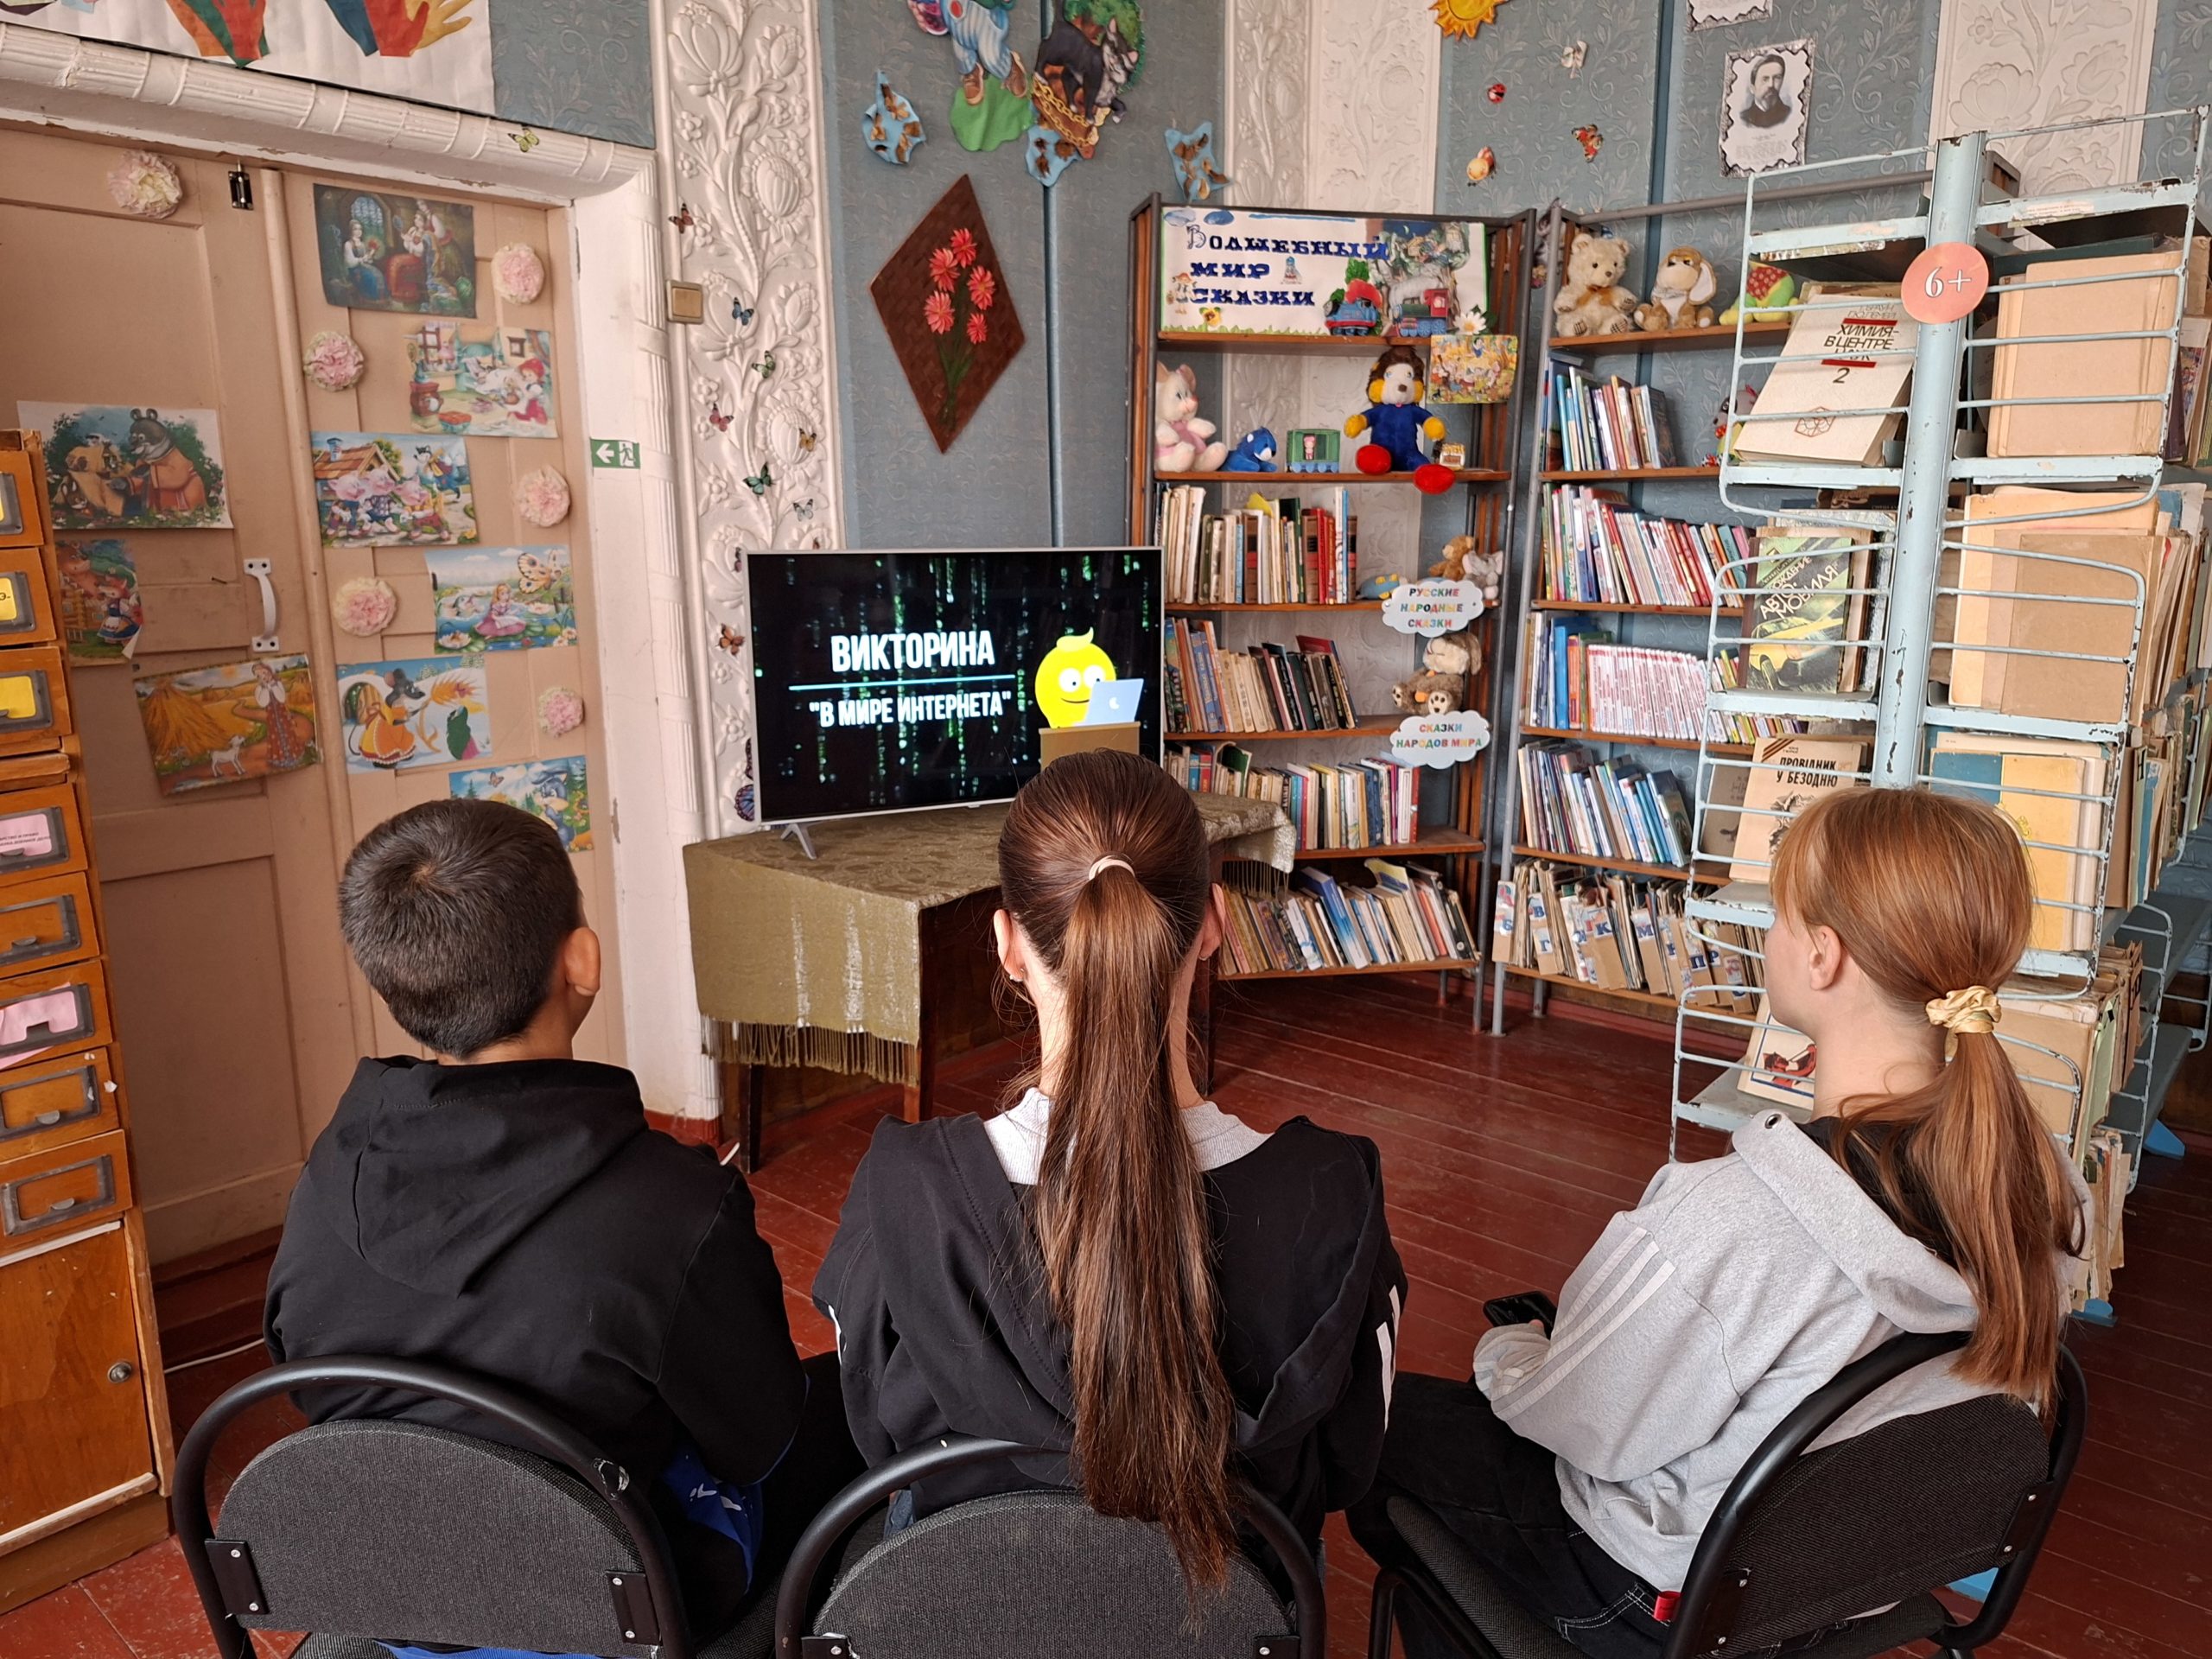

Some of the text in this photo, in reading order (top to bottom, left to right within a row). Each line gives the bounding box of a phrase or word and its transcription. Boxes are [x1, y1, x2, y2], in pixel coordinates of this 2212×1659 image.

[1924, 266, 1972, 298] 6+
[1824, 335, 1894, 350] В ЦЕНТРЕ
[1833, 367, 1851, 384] 2
[1408, 588, 1460, 598] РУССКИЕ
[1400, 603, 1464, 613] НАРОДНЫЕ
[1408, 619, 1452, 628] СКАЗКИ
[830, 630, 995, 672] ВИКТОРИНА
[809, 691, 1012, 728] "В МИРЕ ИНТЕРНЕТА"
[1419, 723, 1463, 733] СКАЗКИ
[1396, 738, 1483, 748] НАРОДОВ МИРА
[1776, 770, 1839, 788] У БЕЗОДНЮ
[1595, 922, 1612, 935] К
[1636, 925, 1654, 938] М
[1690, 955, 1706, 968] П
